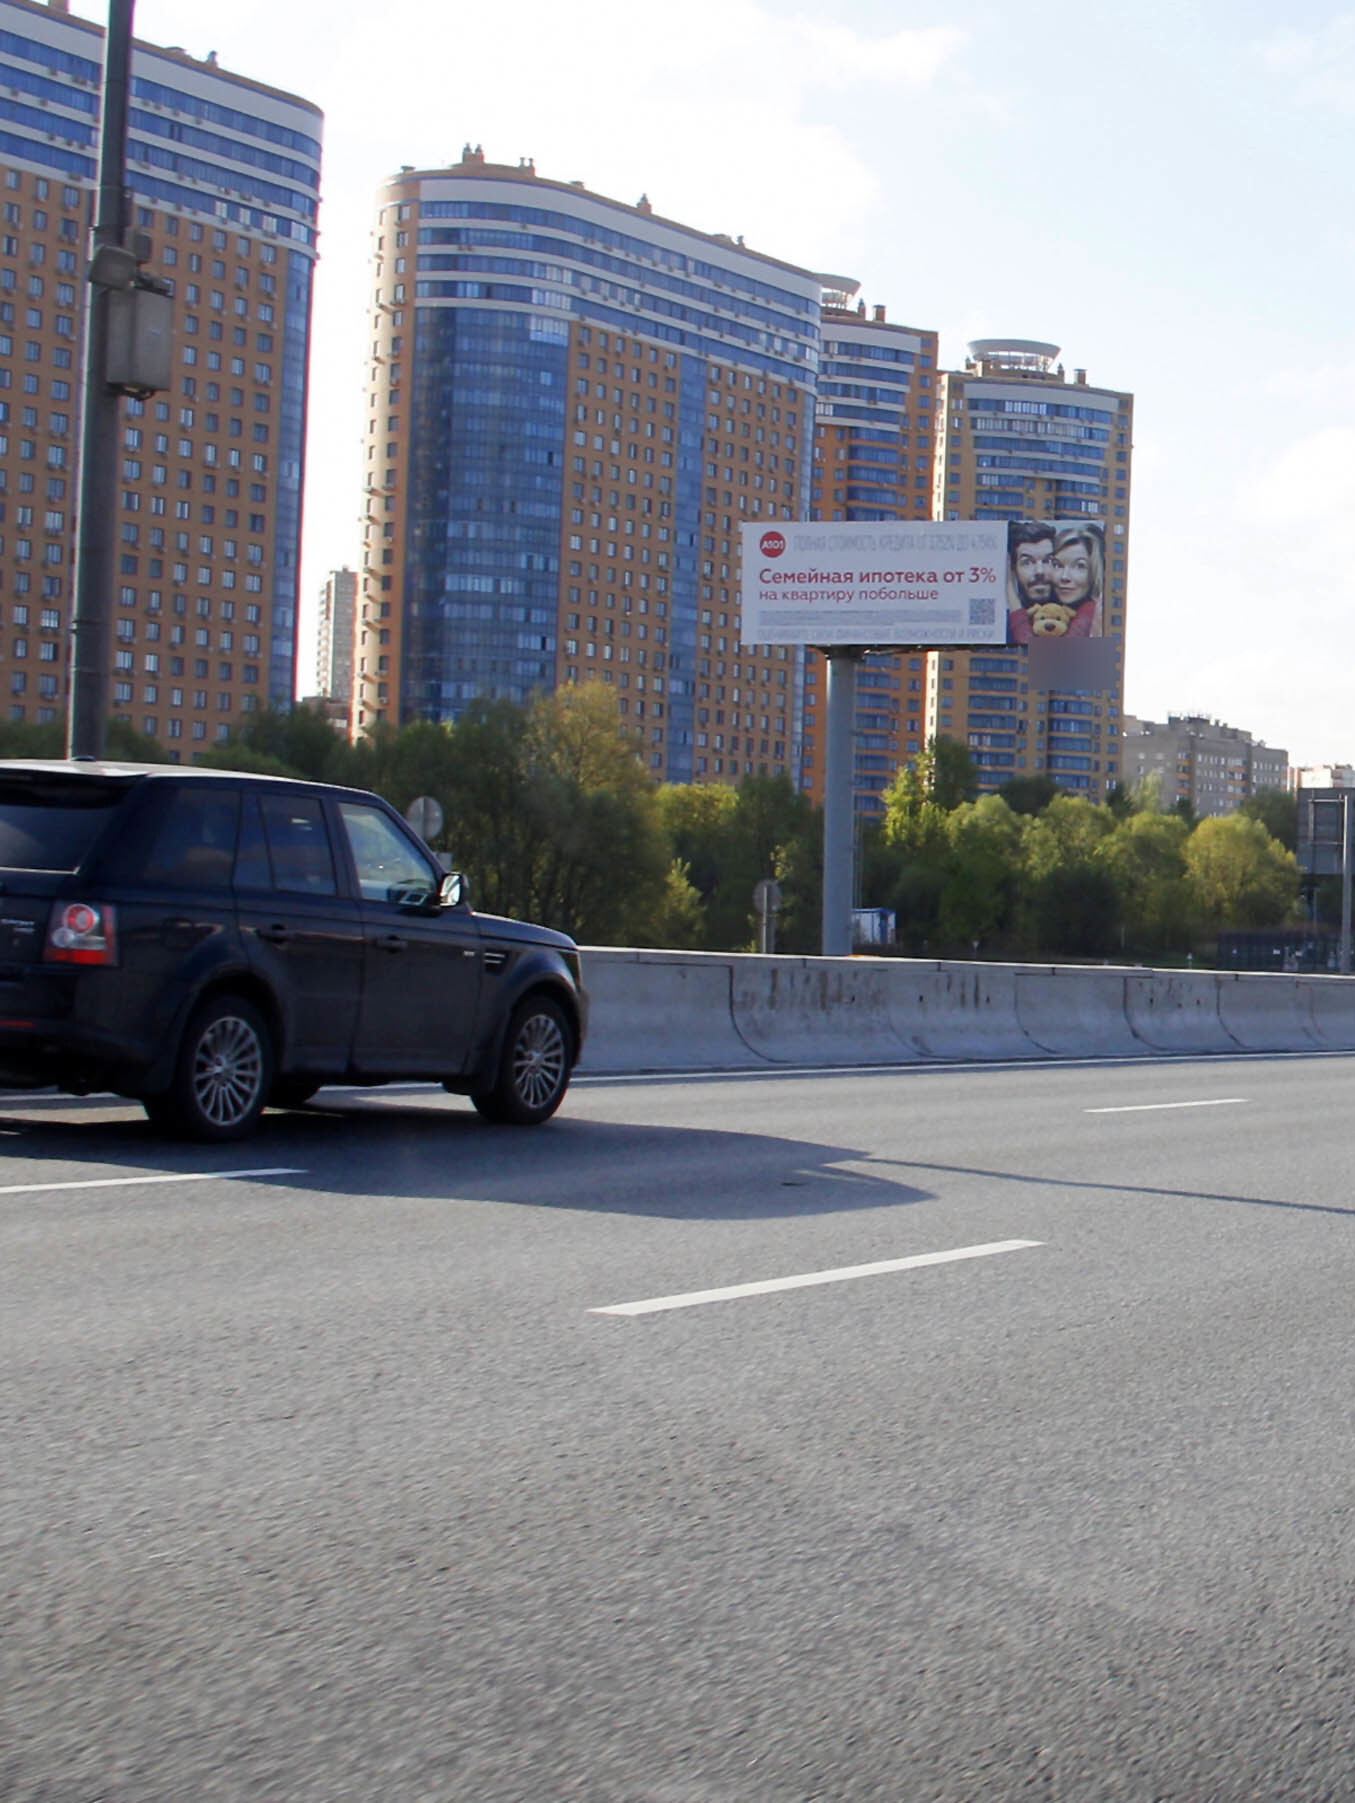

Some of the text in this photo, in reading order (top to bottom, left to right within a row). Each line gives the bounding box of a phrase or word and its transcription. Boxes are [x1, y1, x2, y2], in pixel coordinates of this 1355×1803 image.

[759, 567, 997, 584] Семейная ипотека от 3%
[759, 587, 940, 603] на квартиру побольше
